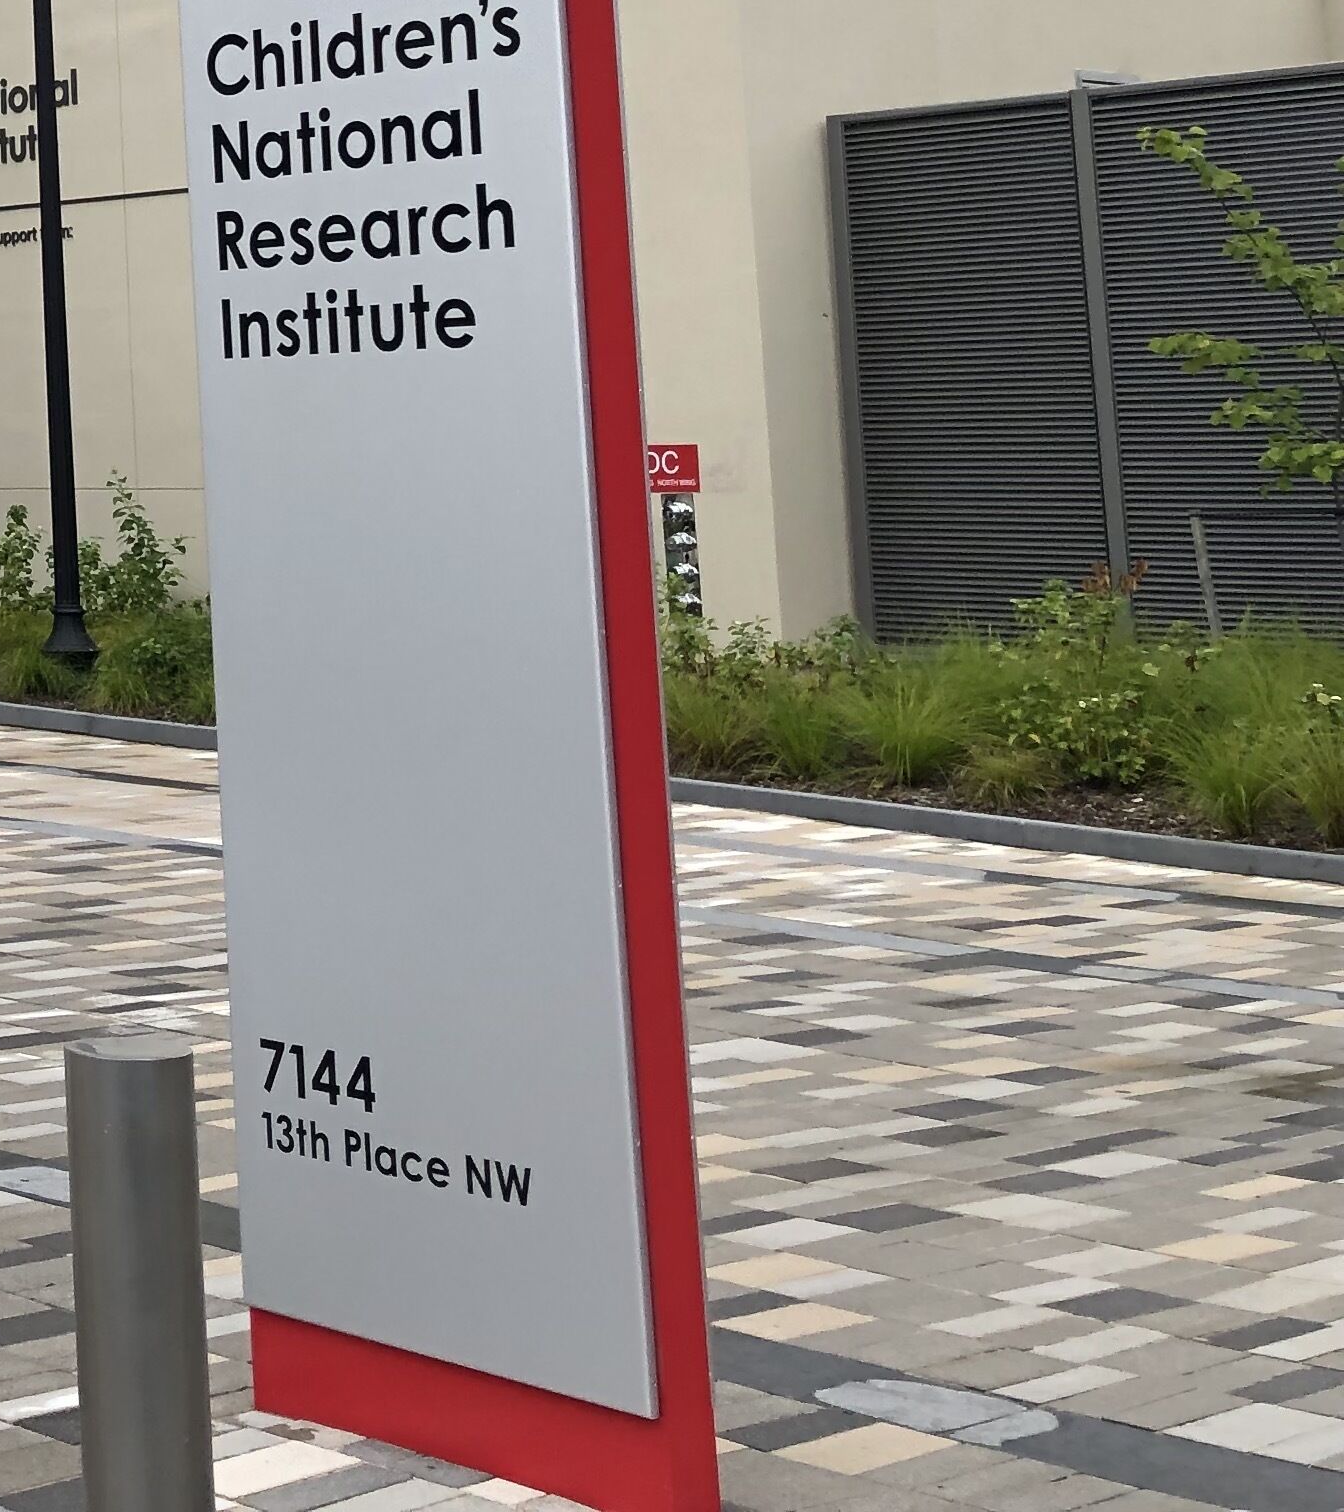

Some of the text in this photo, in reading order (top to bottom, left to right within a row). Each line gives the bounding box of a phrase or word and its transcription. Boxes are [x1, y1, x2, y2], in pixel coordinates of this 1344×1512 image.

[212, 89, 482, 183] National
[216, 183, 515, 271] Research
[221, 285, 476, 358] Institute
[647, 450, 679, 474] DC
[260, 1038, 376, 1113] 7144
[262, 1111, 531, 1206] 13th Place NW
